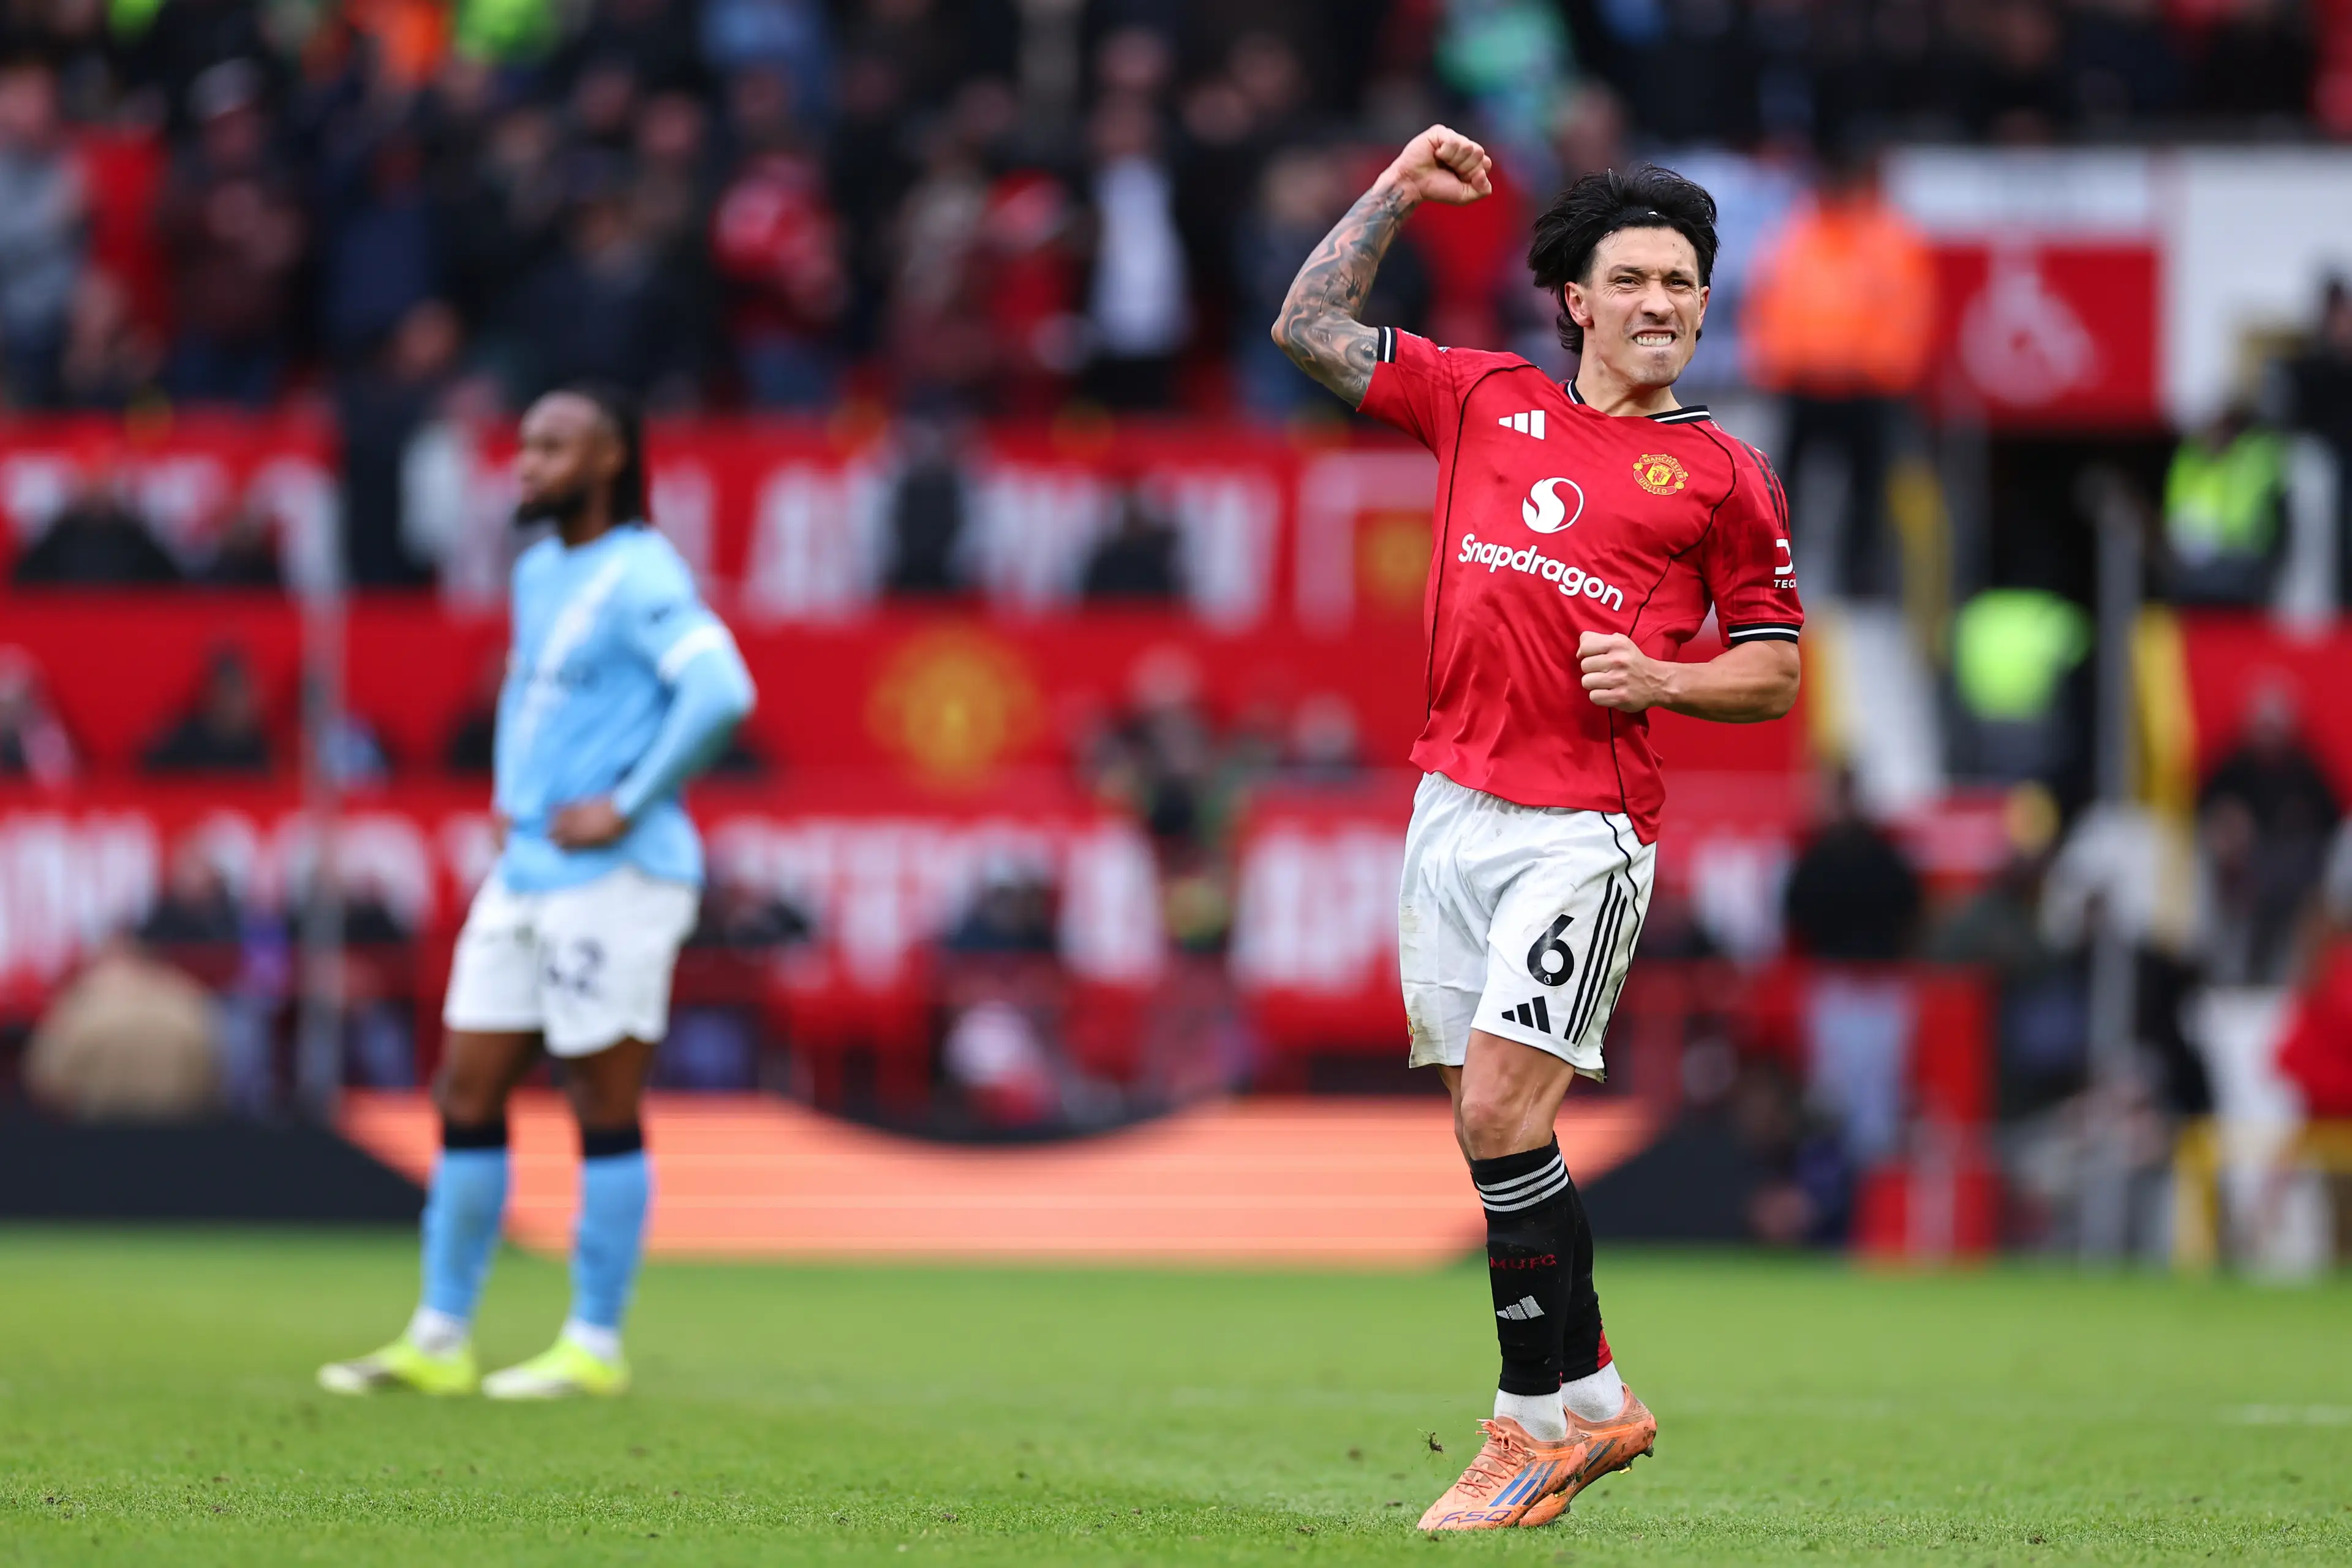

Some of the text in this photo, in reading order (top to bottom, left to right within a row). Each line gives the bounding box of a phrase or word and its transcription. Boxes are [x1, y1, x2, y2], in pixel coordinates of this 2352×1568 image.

[1638, 477, 1667, 494] UNITED
[1643, 456, 1684, 478] MANCHESTER
[1458, 533, 1624, 611] Snapdragon
[1527, 914, 1575, 987] 6
